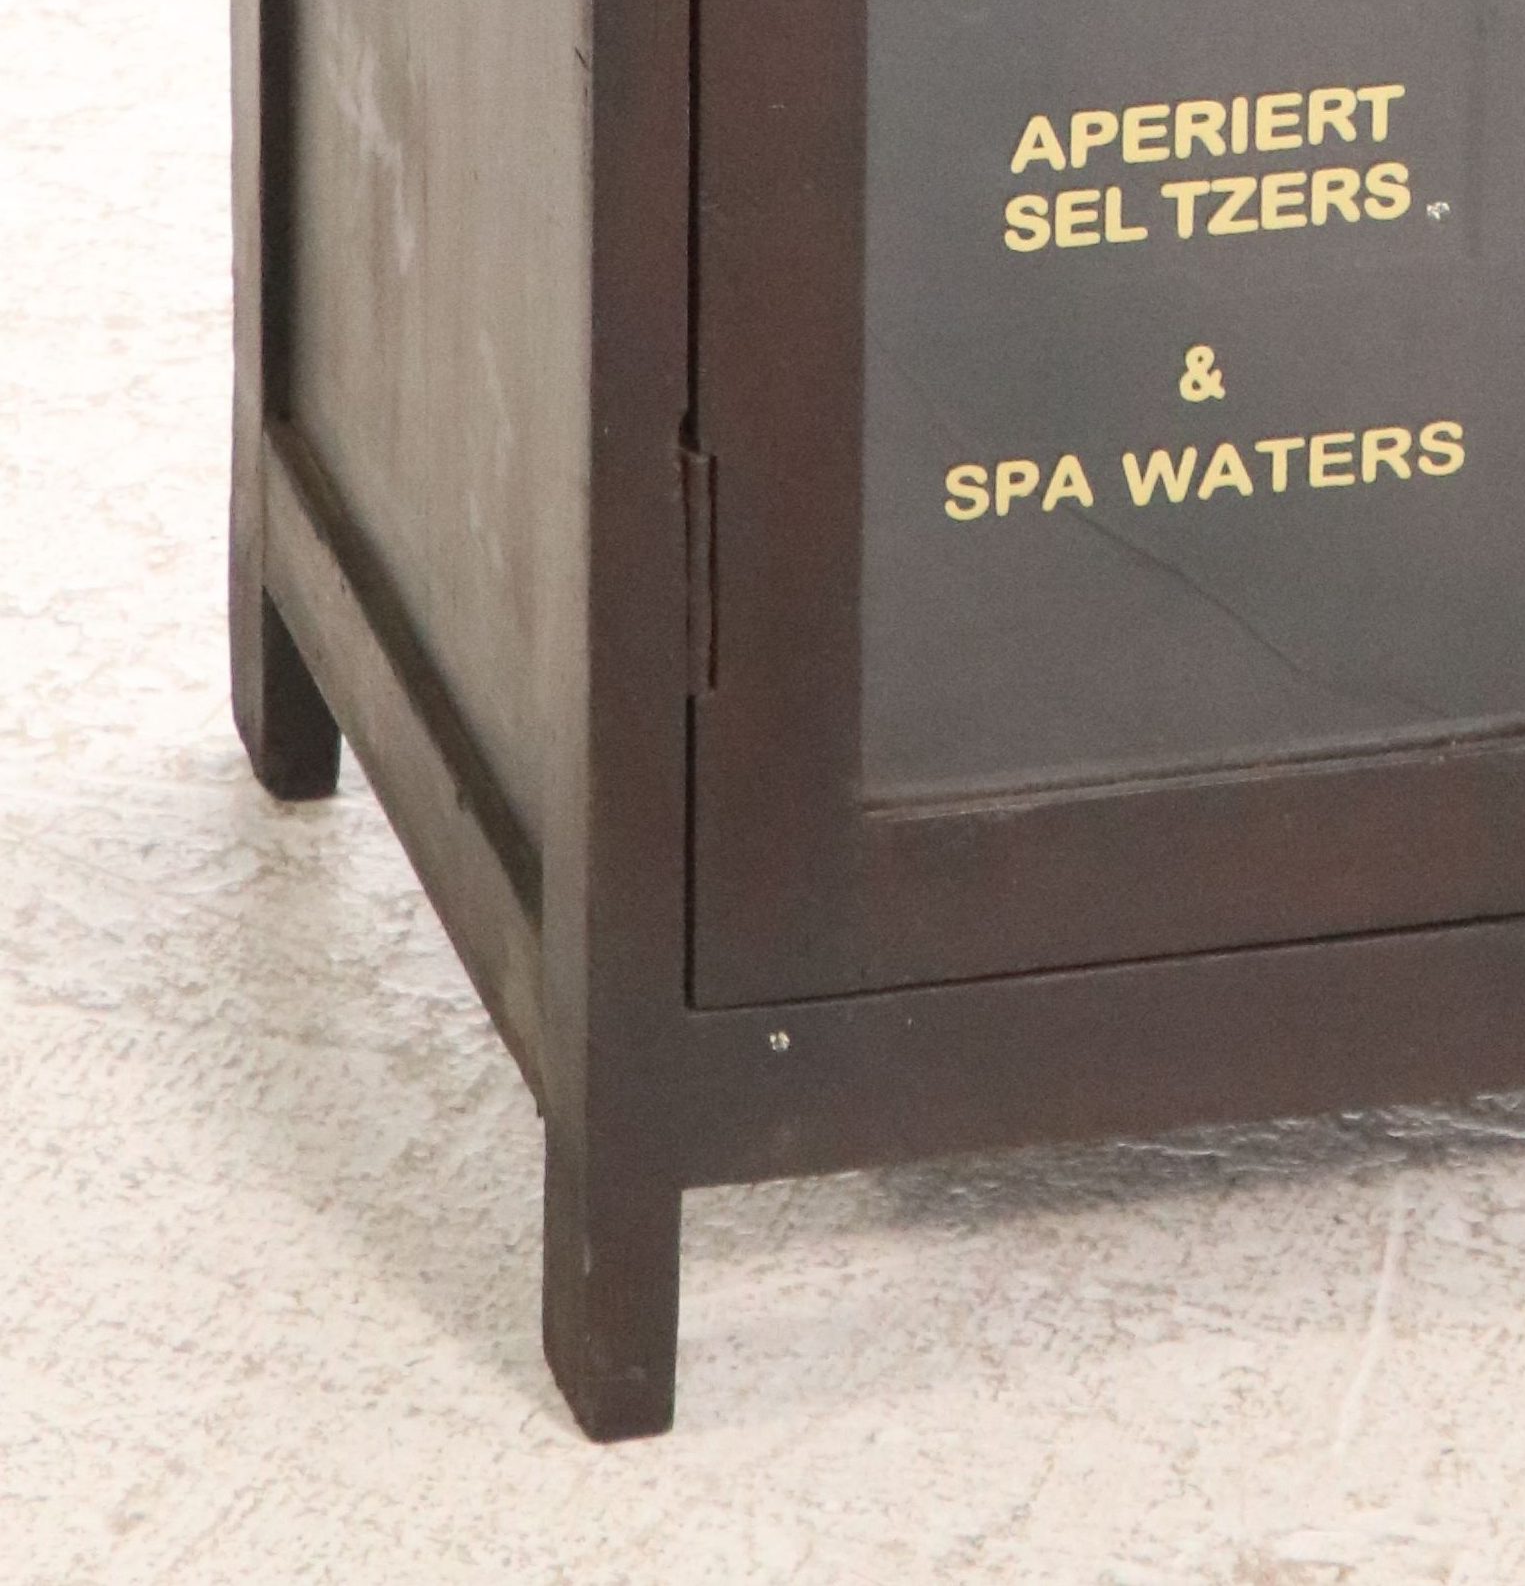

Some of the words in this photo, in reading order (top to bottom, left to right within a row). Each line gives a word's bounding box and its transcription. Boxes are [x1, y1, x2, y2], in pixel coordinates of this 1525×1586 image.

[1009, 82, 1406, 174] APERIERT
[1178, 343, 1227, 404] &
[943, 450, 1096, 522] SPA
[1120, 419, 1467, 508] WATERS
